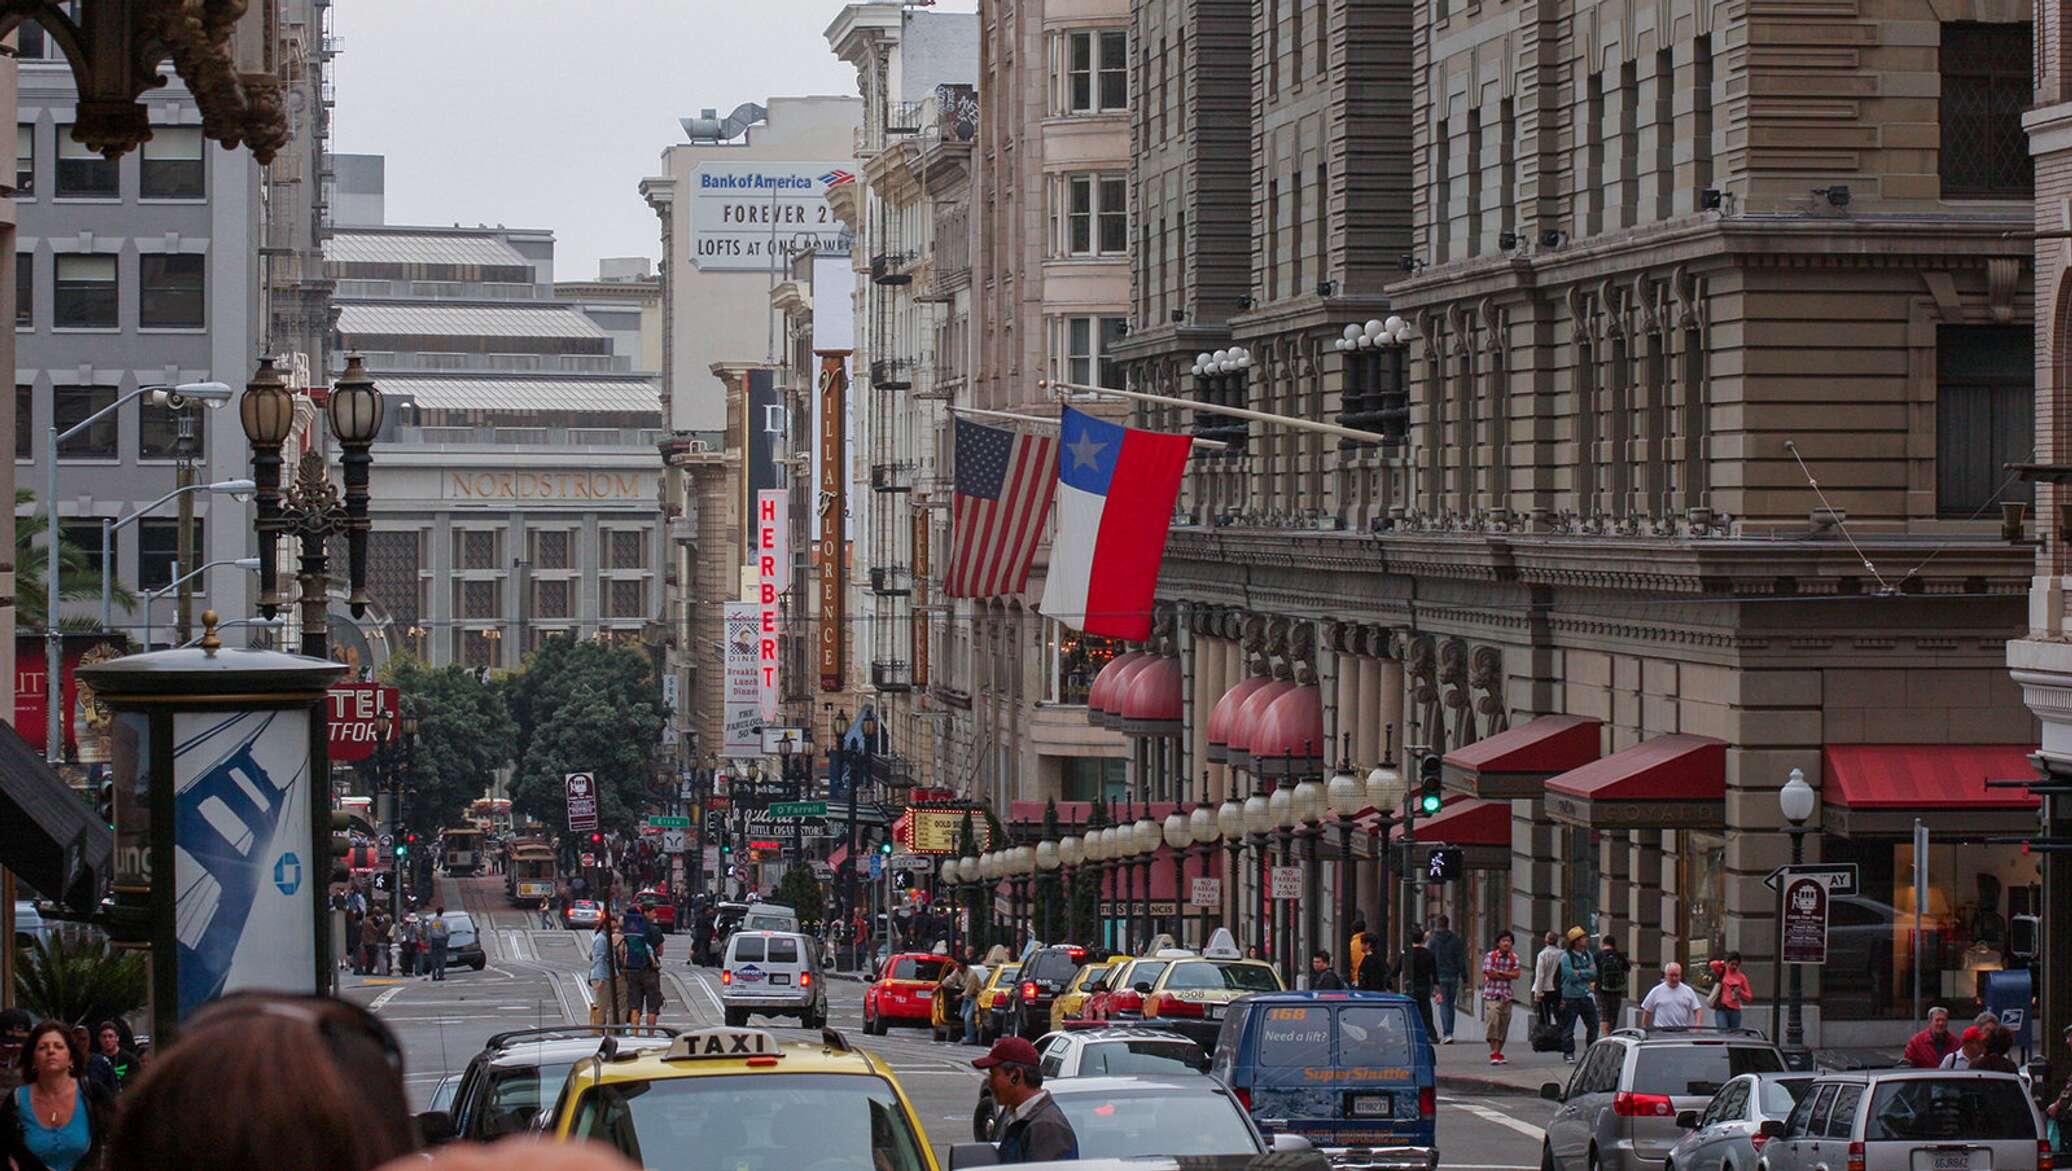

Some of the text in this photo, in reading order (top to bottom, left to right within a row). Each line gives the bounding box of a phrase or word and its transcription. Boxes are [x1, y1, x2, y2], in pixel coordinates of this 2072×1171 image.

[701, 173, 812, 189] Bank of America
[723, 205, 805, 224] FOREVER
[698, 239, 741, 256] LOFTS
[747, 242, 761, 256] AT
[767, 239, 796, 257] ONE
[818, 367, 842, 485] VILLA
[452, 471, 641, 498] NORDSTROM
[818, 490, 838, 666] FLORENCE
[761, 499, 776, 689] HERBERT
[727, 667, 758, 676] Breakfa
[327, 722, 393, 741] TFOR
[1830, 875, 1848, 886] AY
[1269, 1007, 1307, 1021] 168
[683, 1034, 764, 1055] TAXI
[1264, 1031, 1327, 1043] Need a lift?
